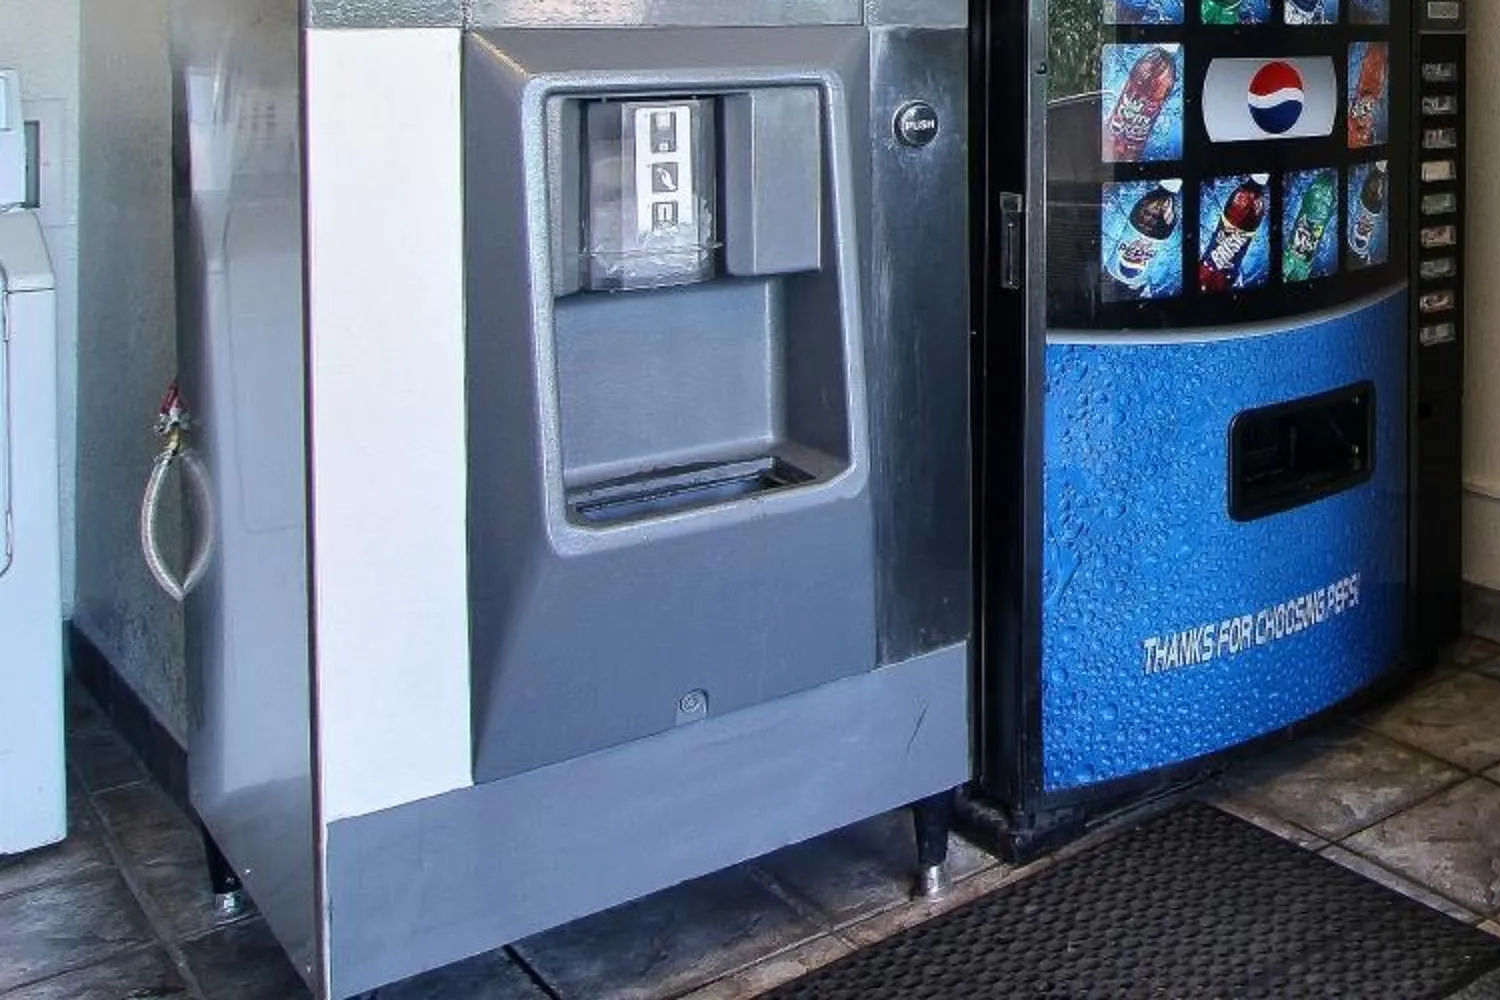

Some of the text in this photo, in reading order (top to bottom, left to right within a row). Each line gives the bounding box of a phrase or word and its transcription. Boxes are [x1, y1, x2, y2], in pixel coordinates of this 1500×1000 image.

[905, 119, 935, 131] PUSH
[1143, 622, 1215, 676] THANKS
[1216, 613, 1254, 657] FOR
[1255, 590, 1326, 646] CHOOSING
